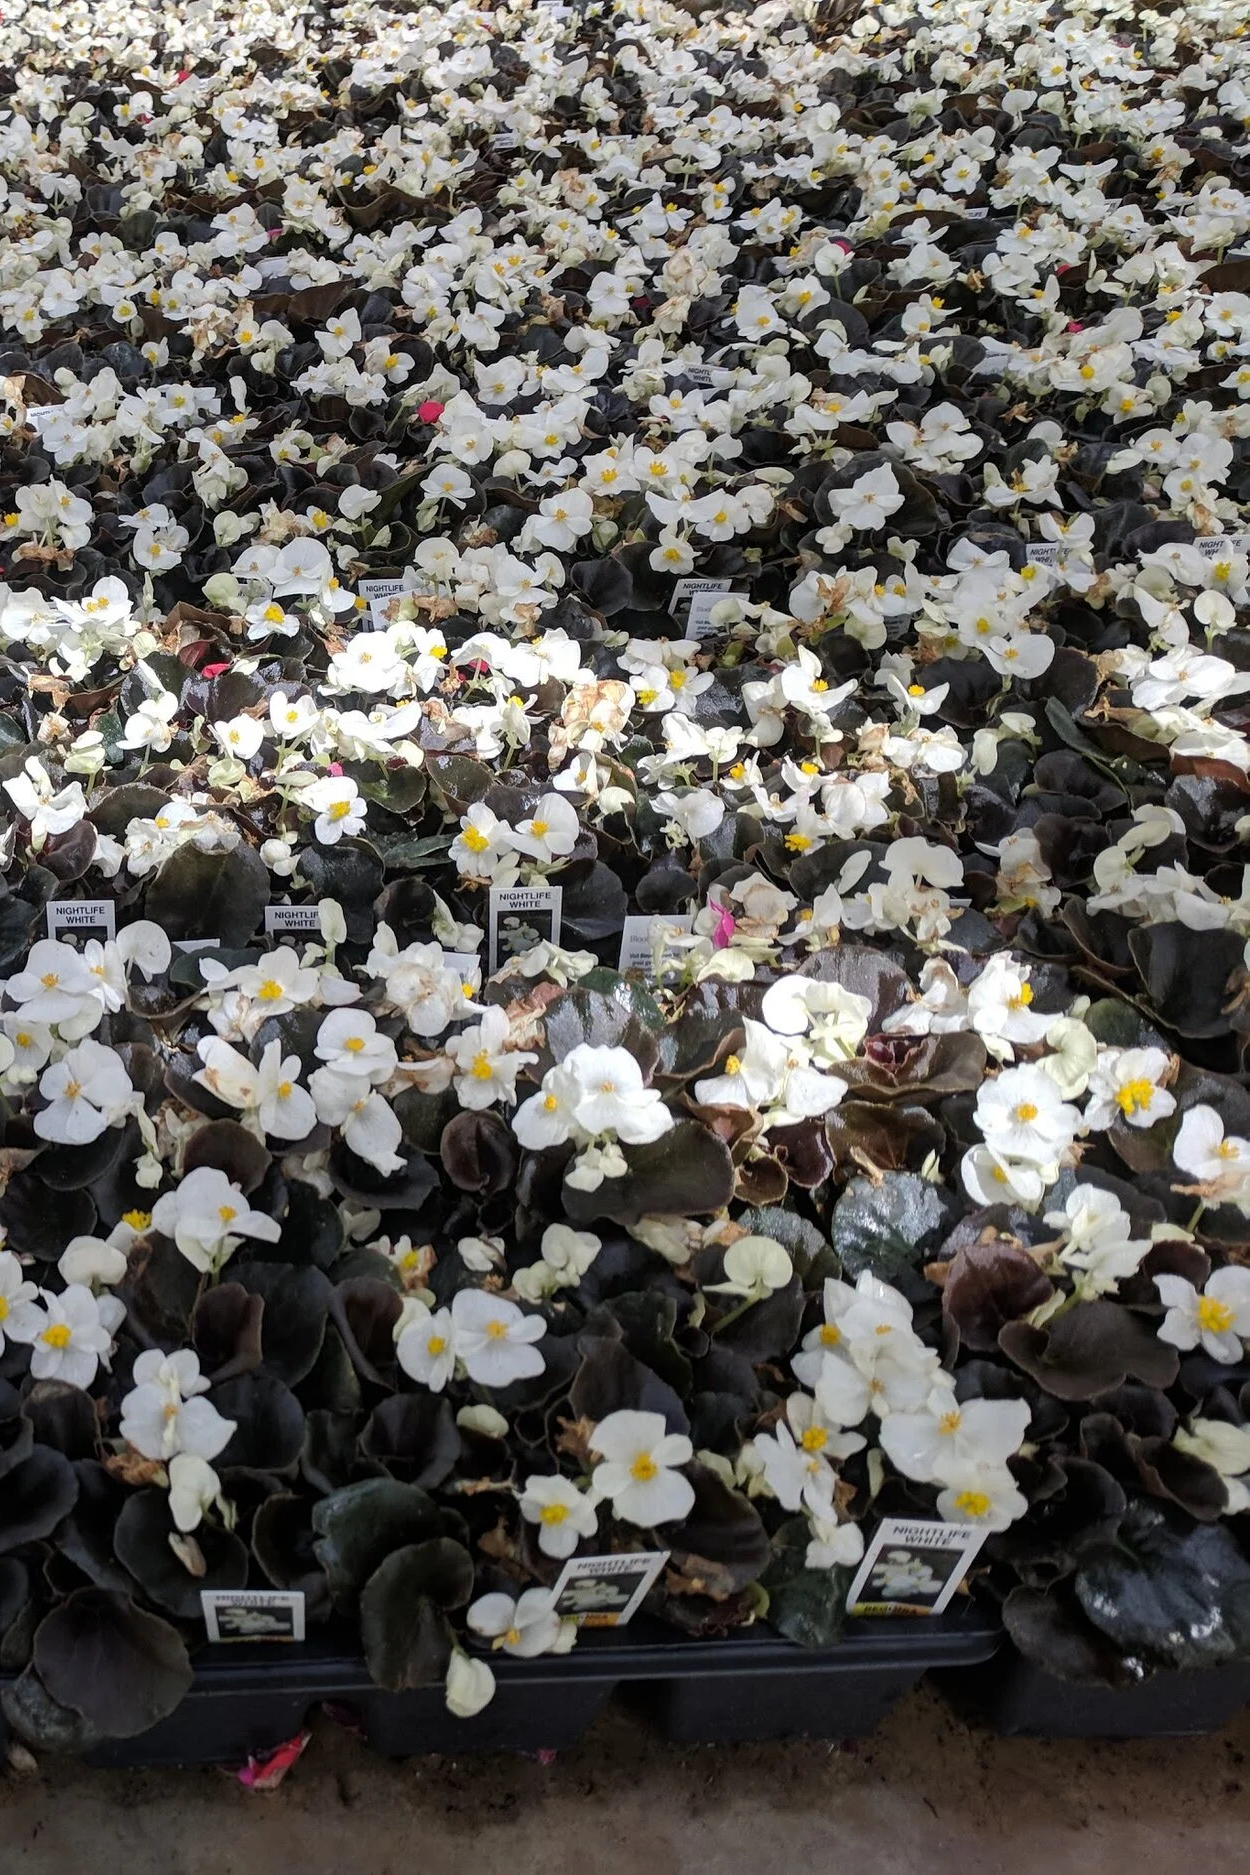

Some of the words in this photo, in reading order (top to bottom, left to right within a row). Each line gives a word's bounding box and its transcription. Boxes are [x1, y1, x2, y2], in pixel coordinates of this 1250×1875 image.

[688, 367, 711, 376] NIGHTL
[1199, 540, 1243, 549] NIGHTFE
[365, 584, 404, 593] NIGHTLIFE
[682, 582, 724, 590] NIGHTLIFE
[499, 891, 552, 901] NIGHTLIFE
[509, 900, 541, 908] WHITE
[55, 906, 106, 916] NIGHTLIFE
[274, 911, 319, 920] NIGHTLIF
[65, 915, 96, 924] WHITE
[284, 919, 316, 928] WHITE
[893, 1525, 973, 1540] NIGHTLIFE
[904, 1536, 952, 1547] WHITE
[577, 1558, 651, 1570] NIGHTLIFE
[589, 1565, 632, 1575] WHITE
